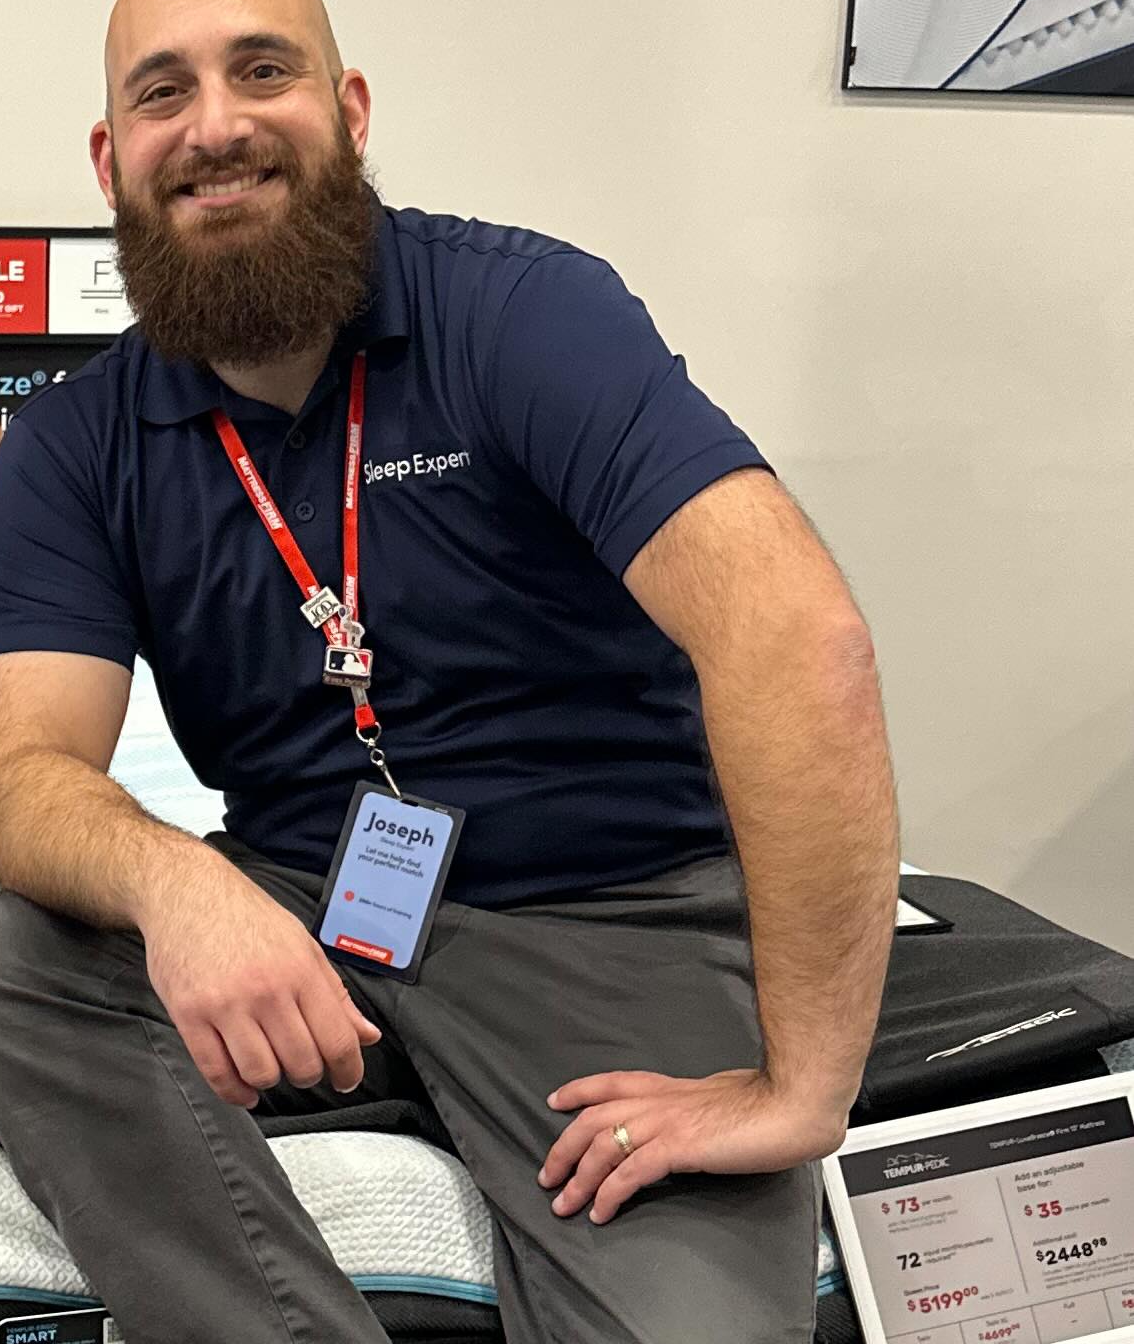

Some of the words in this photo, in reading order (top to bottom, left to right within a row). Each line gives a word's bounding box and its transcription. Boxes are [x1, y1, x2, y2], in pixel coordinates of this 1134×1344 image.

[363, 459, 411, 485] Sleep
[363, 812, 434, 847] Joseph
[896, 1252, 923, 1271] 72
